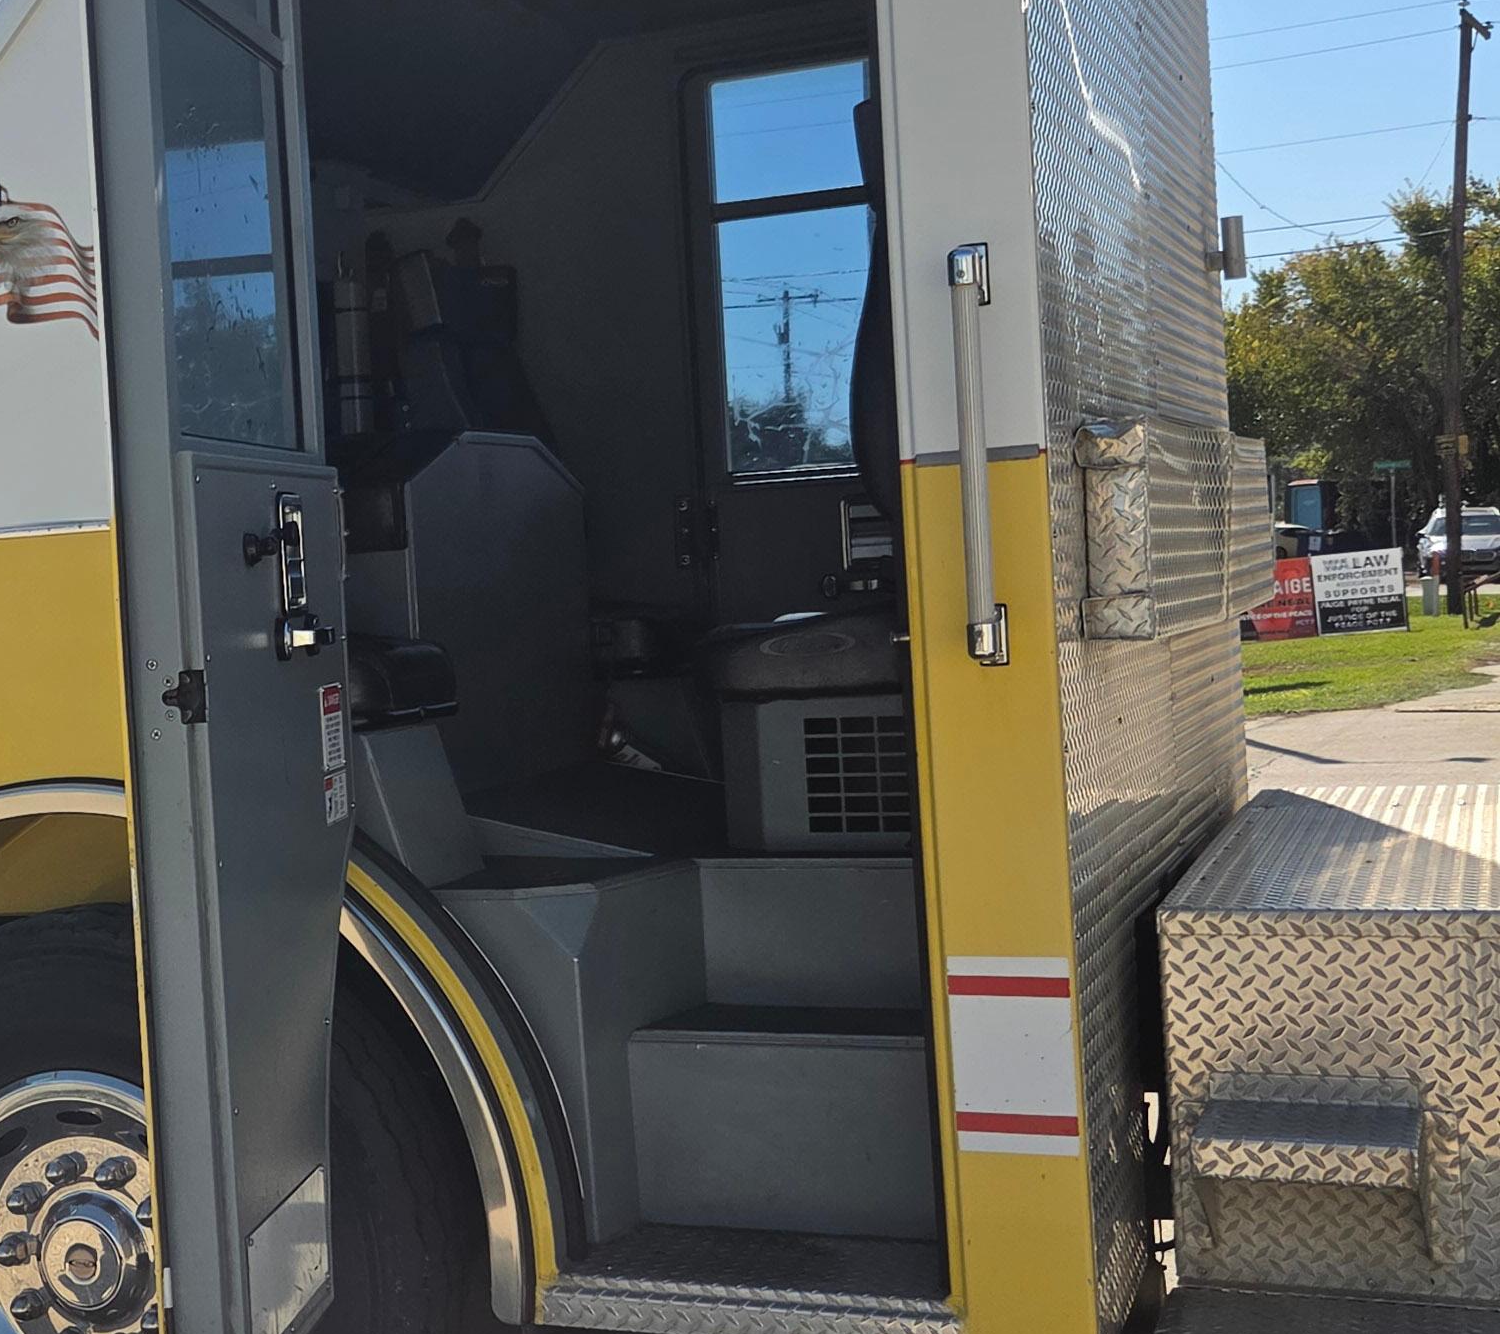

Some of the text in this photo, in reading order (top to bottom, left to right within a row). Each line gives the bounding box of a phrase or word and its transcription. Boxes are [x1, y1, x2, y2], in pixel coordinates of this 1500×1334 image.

[1352, 554, 1388, 569] LAW
[1316, 567, 1398, 582] ENFORCEMENT
[1273, 577, 1312, 595] AIGE
[1324, 584, 1395, 598] SUPPORTS
